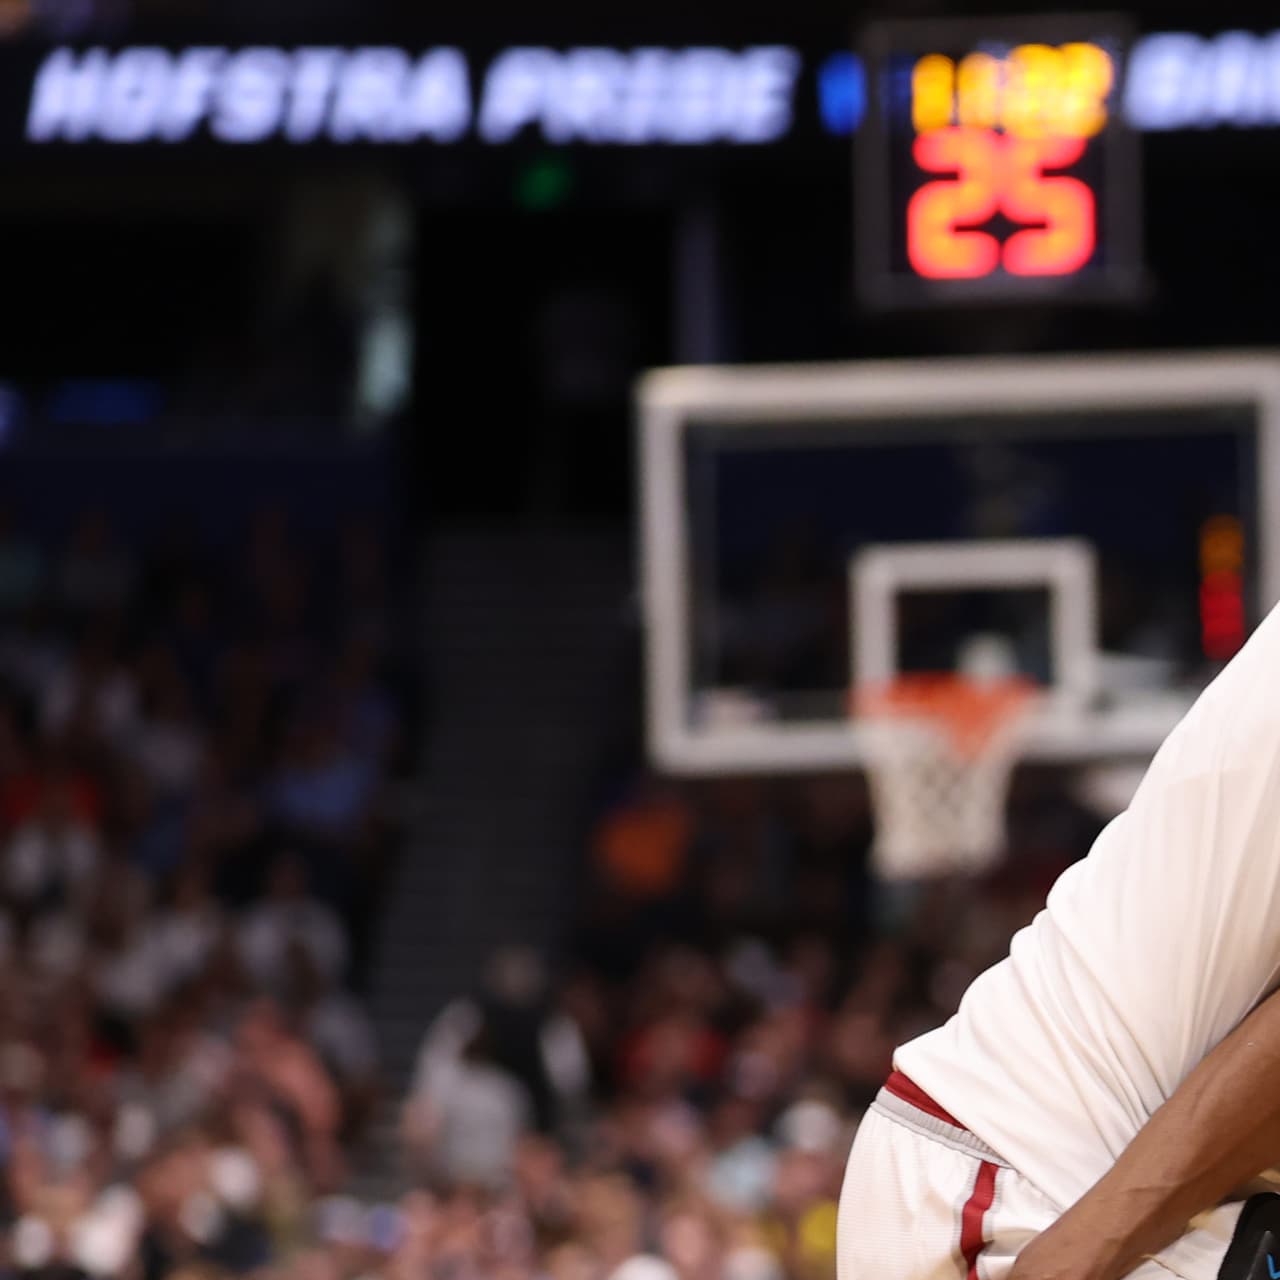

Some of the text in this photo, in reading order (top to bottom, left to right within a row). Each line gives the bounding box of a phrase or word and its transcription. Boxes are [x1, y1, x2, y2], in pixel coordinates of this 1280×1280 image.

[27, 45, 801, 146] HOFSTRA PRIDE
[907, 122, 1097, 279] 25
